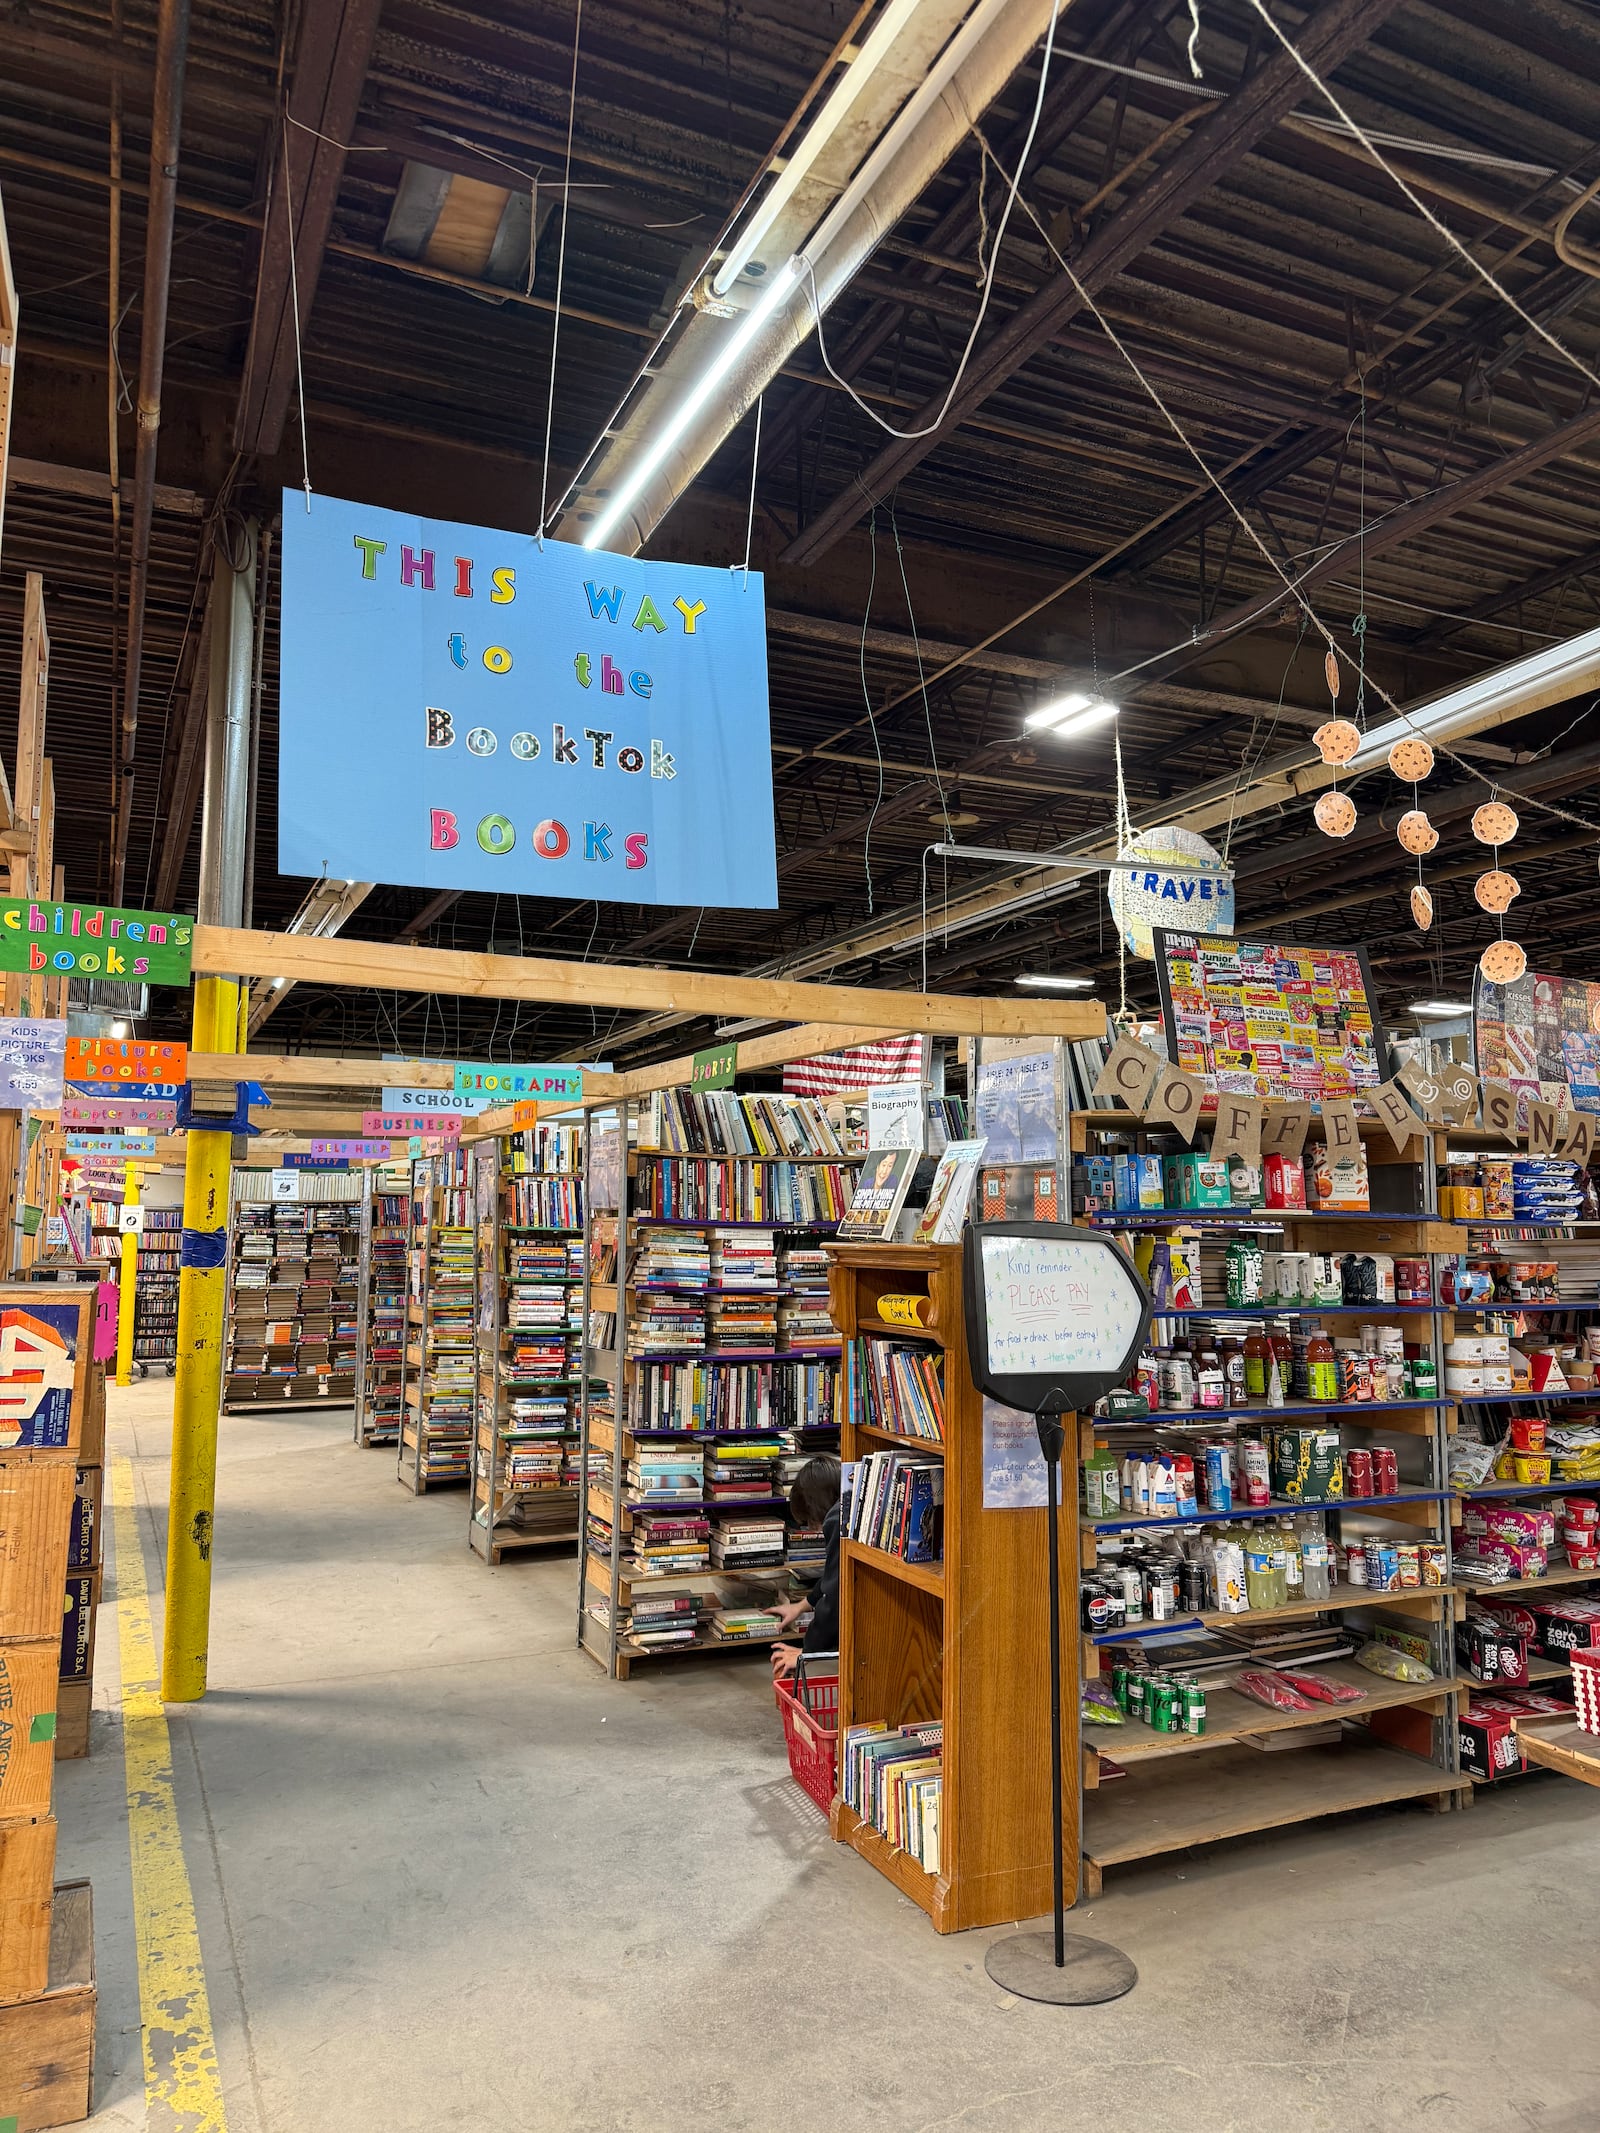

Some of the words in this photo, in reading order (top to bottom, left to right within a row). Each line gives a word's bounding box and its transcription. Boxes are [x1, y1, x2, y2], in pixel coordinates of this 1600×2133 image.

[353, 534, 517, 605] THIS
[583, 580, 708, 635] WAY
[447, 632, 514, 674] to
[573, 652, 654, 699] the
[425, 706, 678, 781] BookTok
[429, 807, 649, 870] BOOKS
[3, 904, 191, 946] children's
[28, 943, 150, 975] books
[1199, 953, 1234, 963] Junior
[1507, 992, 1532, 1003] KISSES
[11, 1027, 41, 1037] KIDS'
[1, 1040, 50, 1050] PICTURE
[86, 1060, 163, 1077] books
[693, 1056, 733, 1083] SPORTS
[1005, 1067, 1013, 1078] 24
[1041, 1060, 1049, 1071] 25
[461, 1074, 581, 1094] BIOGRAPHY
[402, 1092, 475, 1108] SCHOOL
[871, 1099, 919, 1111] Biography
[1115, 1056, 1410, 1147] COFFEE
[64, 1107, 124, 1123] chapter
[130, 1108, 174, 1120] books
[372, 1117, 455, 1131] BUSINESS
[68, 1138, 113, 1151] chapter
[119, 1141, 155, 1151] books
[317, 1143, 347, 1153] SELF
[355, 1144, 388, 1153] HELP
[294, 1156, 339, 1166] History
[790, 1174, 800, 1205] PIECES
[855, 1188, 880, 1201] SIMPLY
[879, 1188, 895, 1201] MING
[989, 1182, 998, 1194] 24
[1041, 1180, 1050, 1192] 25
[873, 1199, 892, 1210] MEALS
[1007, 1250, 1031, 1276] Kind
[1036, 1261, 1073, 1275] reminder
[1007, 1284, 1060, 1309] PLEASE
[1066, 1283, 1090, 1302] PAY
[1007, 1331, 1022, 1349] food
[81, 1498, 92, 1514] DEL
[1503, 1517, 1517, 1525] AIR
[80, 1515, 90, 1546] CURTO
[79, 1547, 89, 1565] S.A.
[1493, 1546, 1505, 1554] AIR
[81, 1579, 90, 1604] DAVID
[77, 1621, 88, 1655] CURTO
[1547, 1627, 1578, 1642] zero
[1547, 1638, 1578, 1650] SUGAR
[1484, 1643, 1492, 1669] SUGAR
[1490, 1644, 1498, 1670] zero
[75, 1655, 85, 1674] S.A.
[1483, 1671, 1494, 1681] 12
